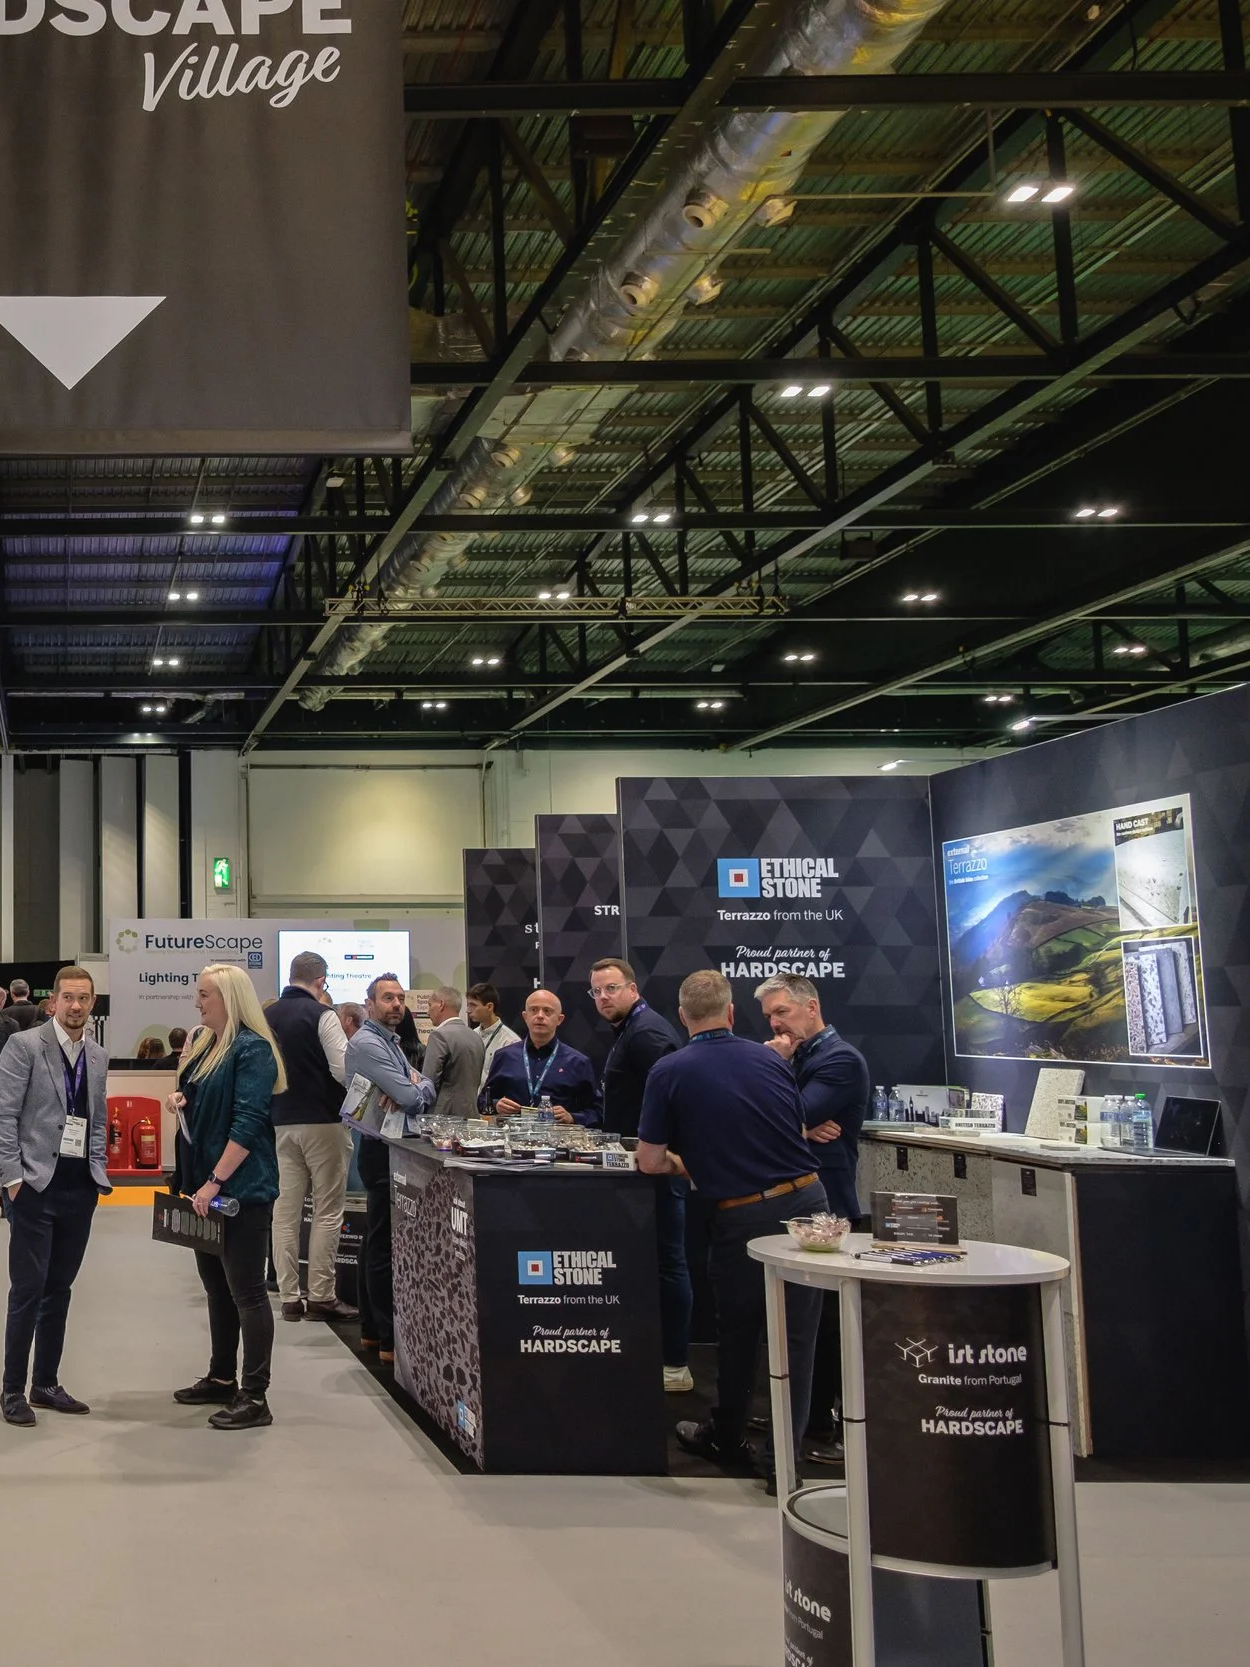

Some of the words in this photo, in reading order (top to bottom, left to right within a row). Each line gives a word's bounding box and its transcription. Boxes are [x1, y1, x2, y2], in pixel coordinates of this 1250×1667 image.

[142, 43, 341, 111] Village
[761, 858, 839, 878] ETHICAL
[948, 858, 988, 875] Terrazzo
[762, 878, 822, 898] STONE
[717, 910, 770, 921] Terrazzo
[774, 910, 801, 921] from
[803, 910, 822, 921] the
[825, 910, 844, 921] UK
[145, 934, 263, 953] FutureScape
[736, 946, 771, 958] Proud
[773, 947, 815, 960] partner
[819, 946, 831, 961] of
[721, 962, 845, 978] HARDSCAPE
[139, 972, 189, 985] Lighting
[553, 1251, 617, 1268] ETHICAL
[554, 1268, 602, 1285] STONE
[518, 1295, 561, 1305] Terrazzo
[563, 1295, 586, 1305] from
[588, 1295, 603, 1305] the
[605, 1295, 620, 1305] UK
[533, 1326, 561, 1337] Proud
[563, 1327, 597, 1339] partner
[600, 1327, 610, 1339] of
[520, 1340, 621, 1353] HARDSCAPE
[948, 1344, 974, 1365] ist
[979, 1344, 1027, 1365] stone
[918, 1374, 962, 1385] Granite
[964, 1376, 988, 1385] from
[989, 1374, 1022, 1387] Portugal
[935, 1406, 968, 1417] Proud
[969, 1408, 1003, 1420] partner
[1005, 1408, 1014, 1420] of
[921, 1419, 1024, 1436] HARDSCAPE
